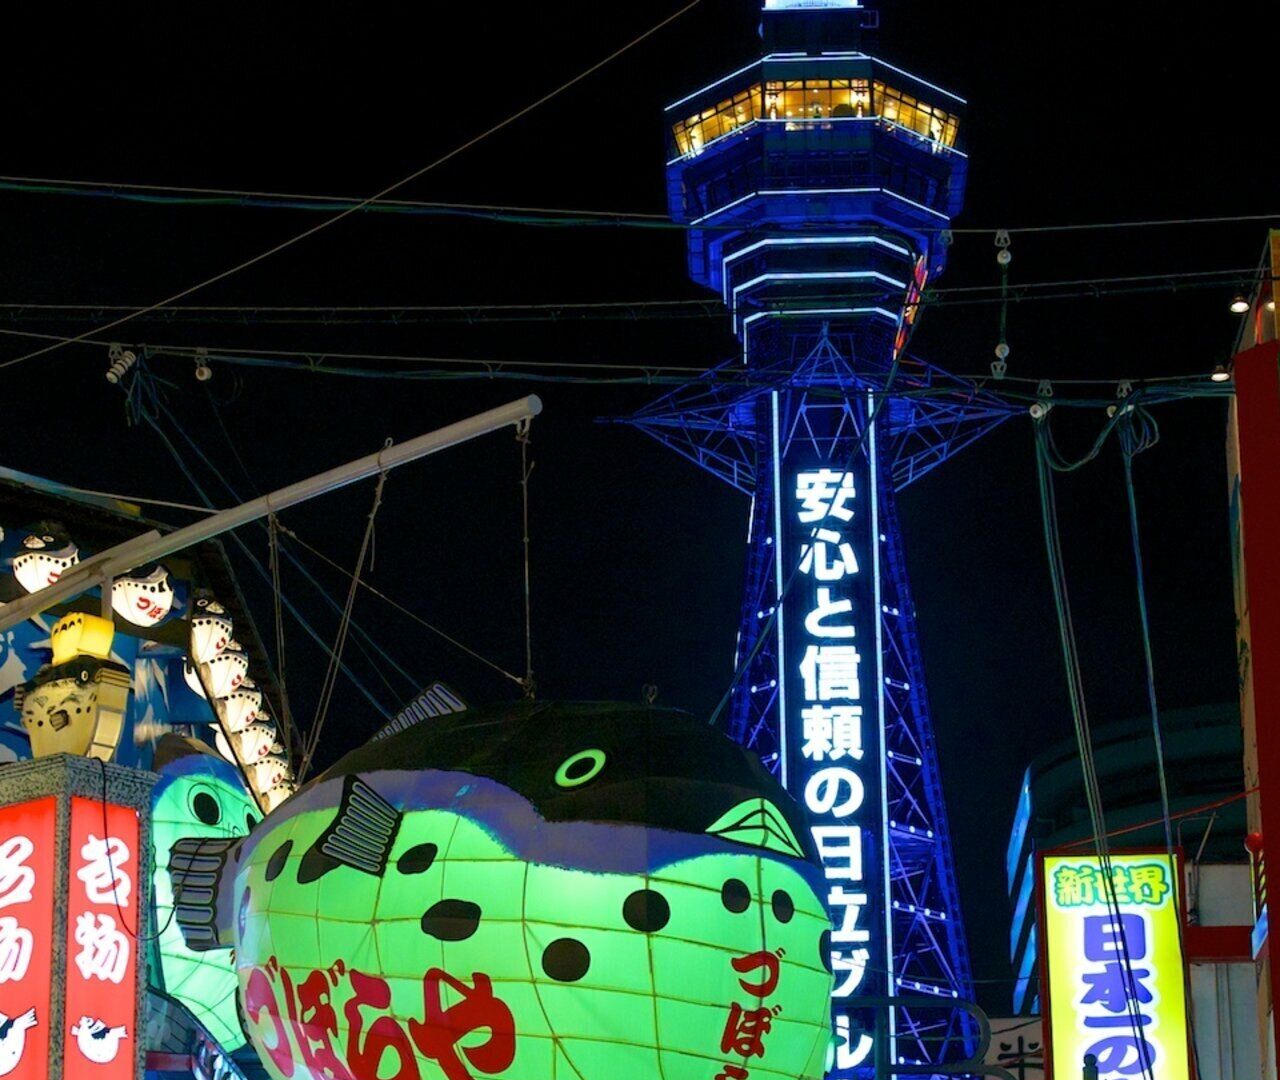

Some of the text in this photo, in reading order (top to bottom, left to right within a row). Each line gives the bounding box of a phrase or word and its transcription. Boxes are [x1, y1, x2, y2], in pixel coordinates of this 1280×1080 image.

[72, 833, 130, 986] 名物
[1054, 865, 1169, 907] 新世界
